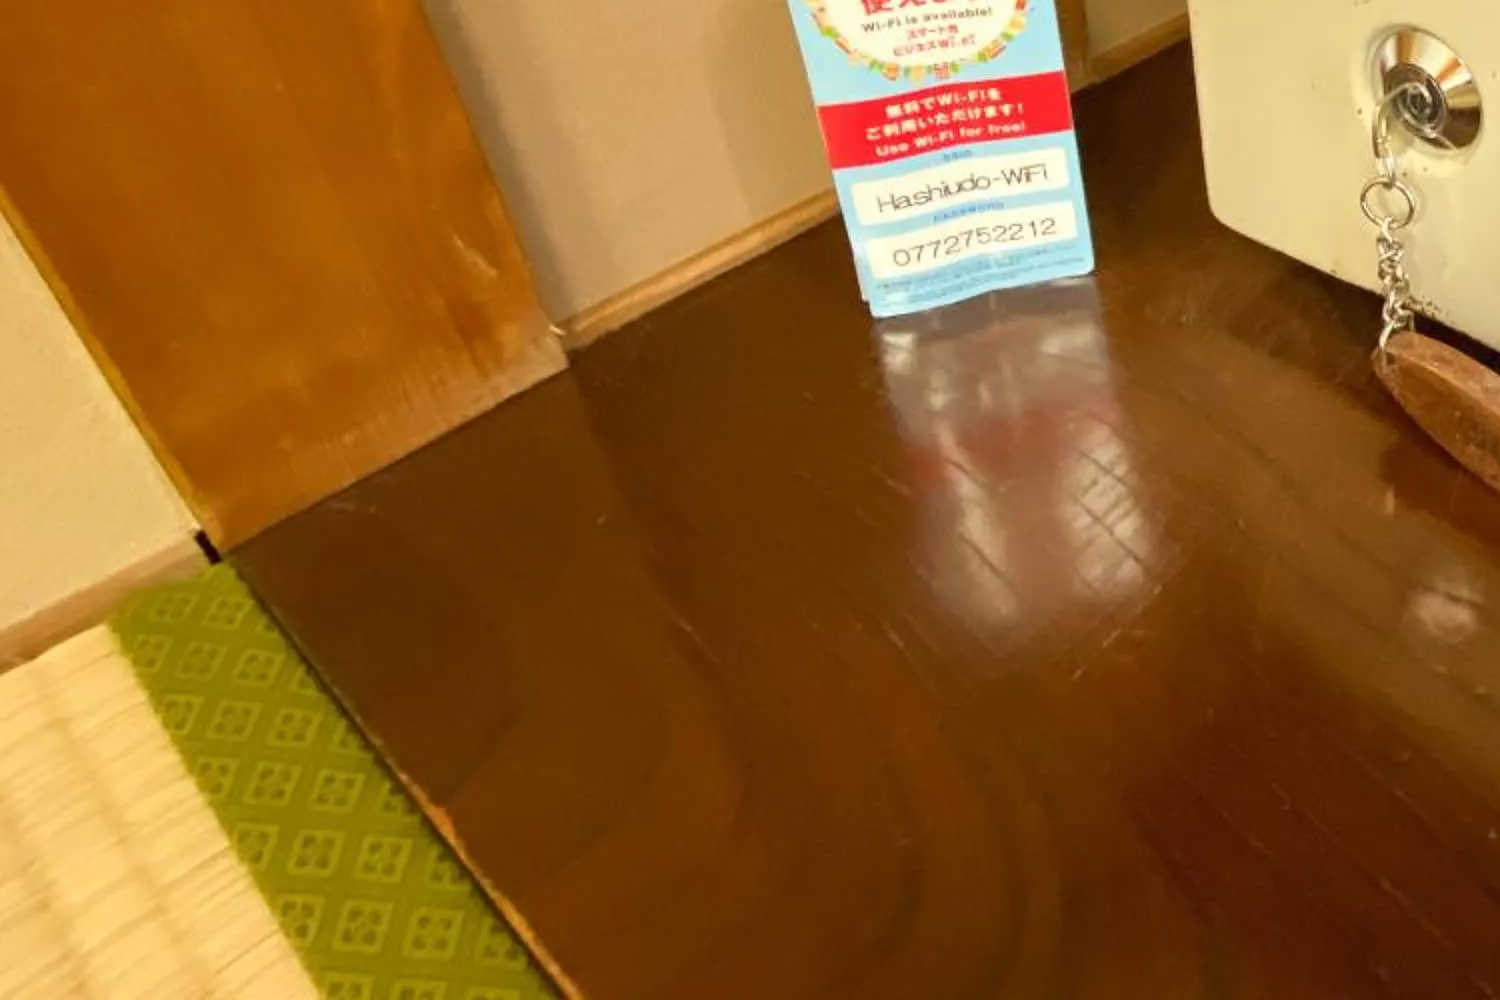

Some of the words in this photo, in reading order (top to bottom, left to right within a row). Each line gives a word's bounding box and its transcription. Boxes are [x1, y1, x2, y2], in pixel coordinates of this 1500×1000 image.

[861, 15, 901, 33] Wi-Fi
[905, 14, 918, 25] is
[923, 7, 993, 22] available!
[875, 142, 909, 157] Use
[914, 130, 954, 148] Wi-Fi
[959, 126, 984, 138] for
[987, 121, 1026, 135] free!
[892, 217, 1057, 267] 0772752212
